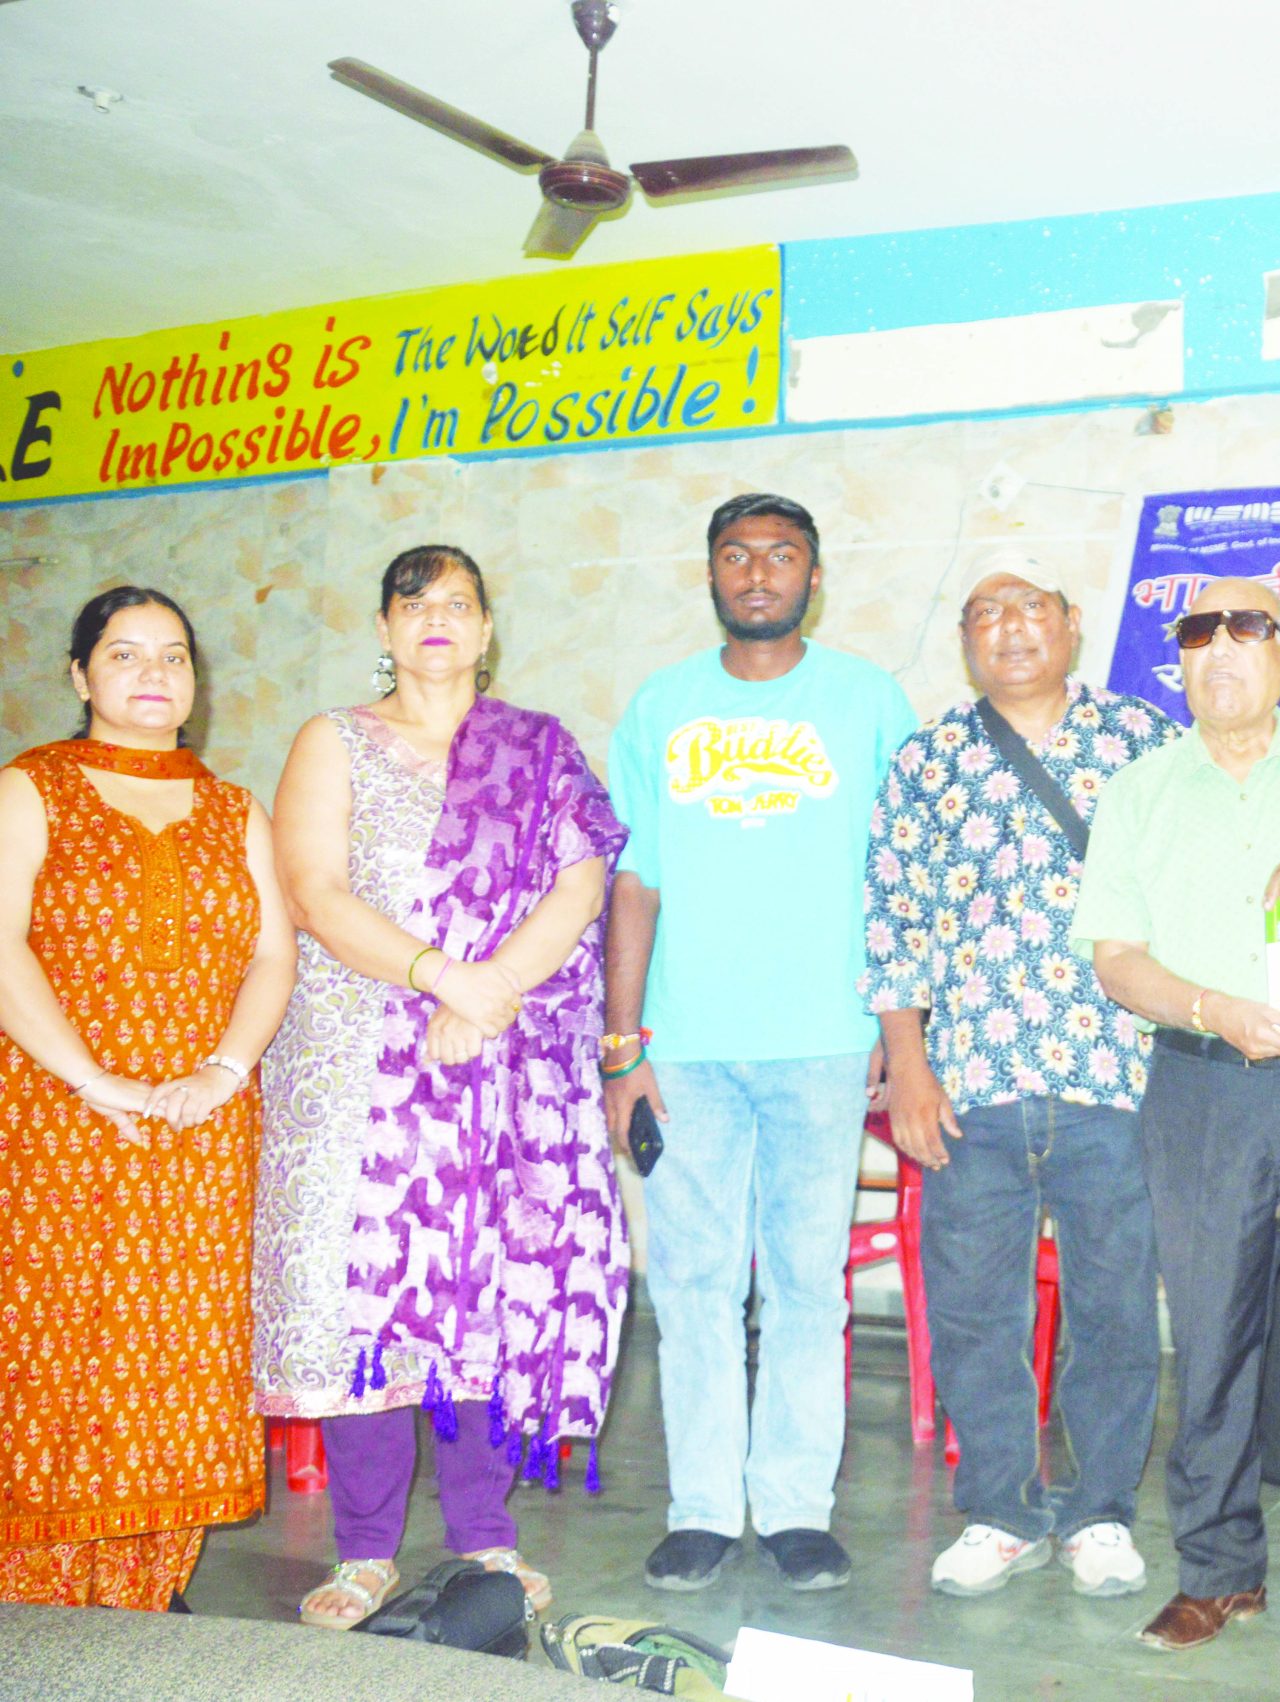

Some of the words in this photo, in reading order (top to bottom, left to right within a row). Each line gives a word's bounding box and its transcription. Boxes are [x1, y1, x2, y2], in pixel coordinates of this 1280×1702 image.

[93, 331, 293, 419] Nothing
[313, 316, 372, 389] is
[394, 326, 456, 377] The
[566, 301, 597, 354] It
[675, 288, 773, 350] Says
[0, 391, 61, 482] E
[389, 394, 459, 454] I'm
